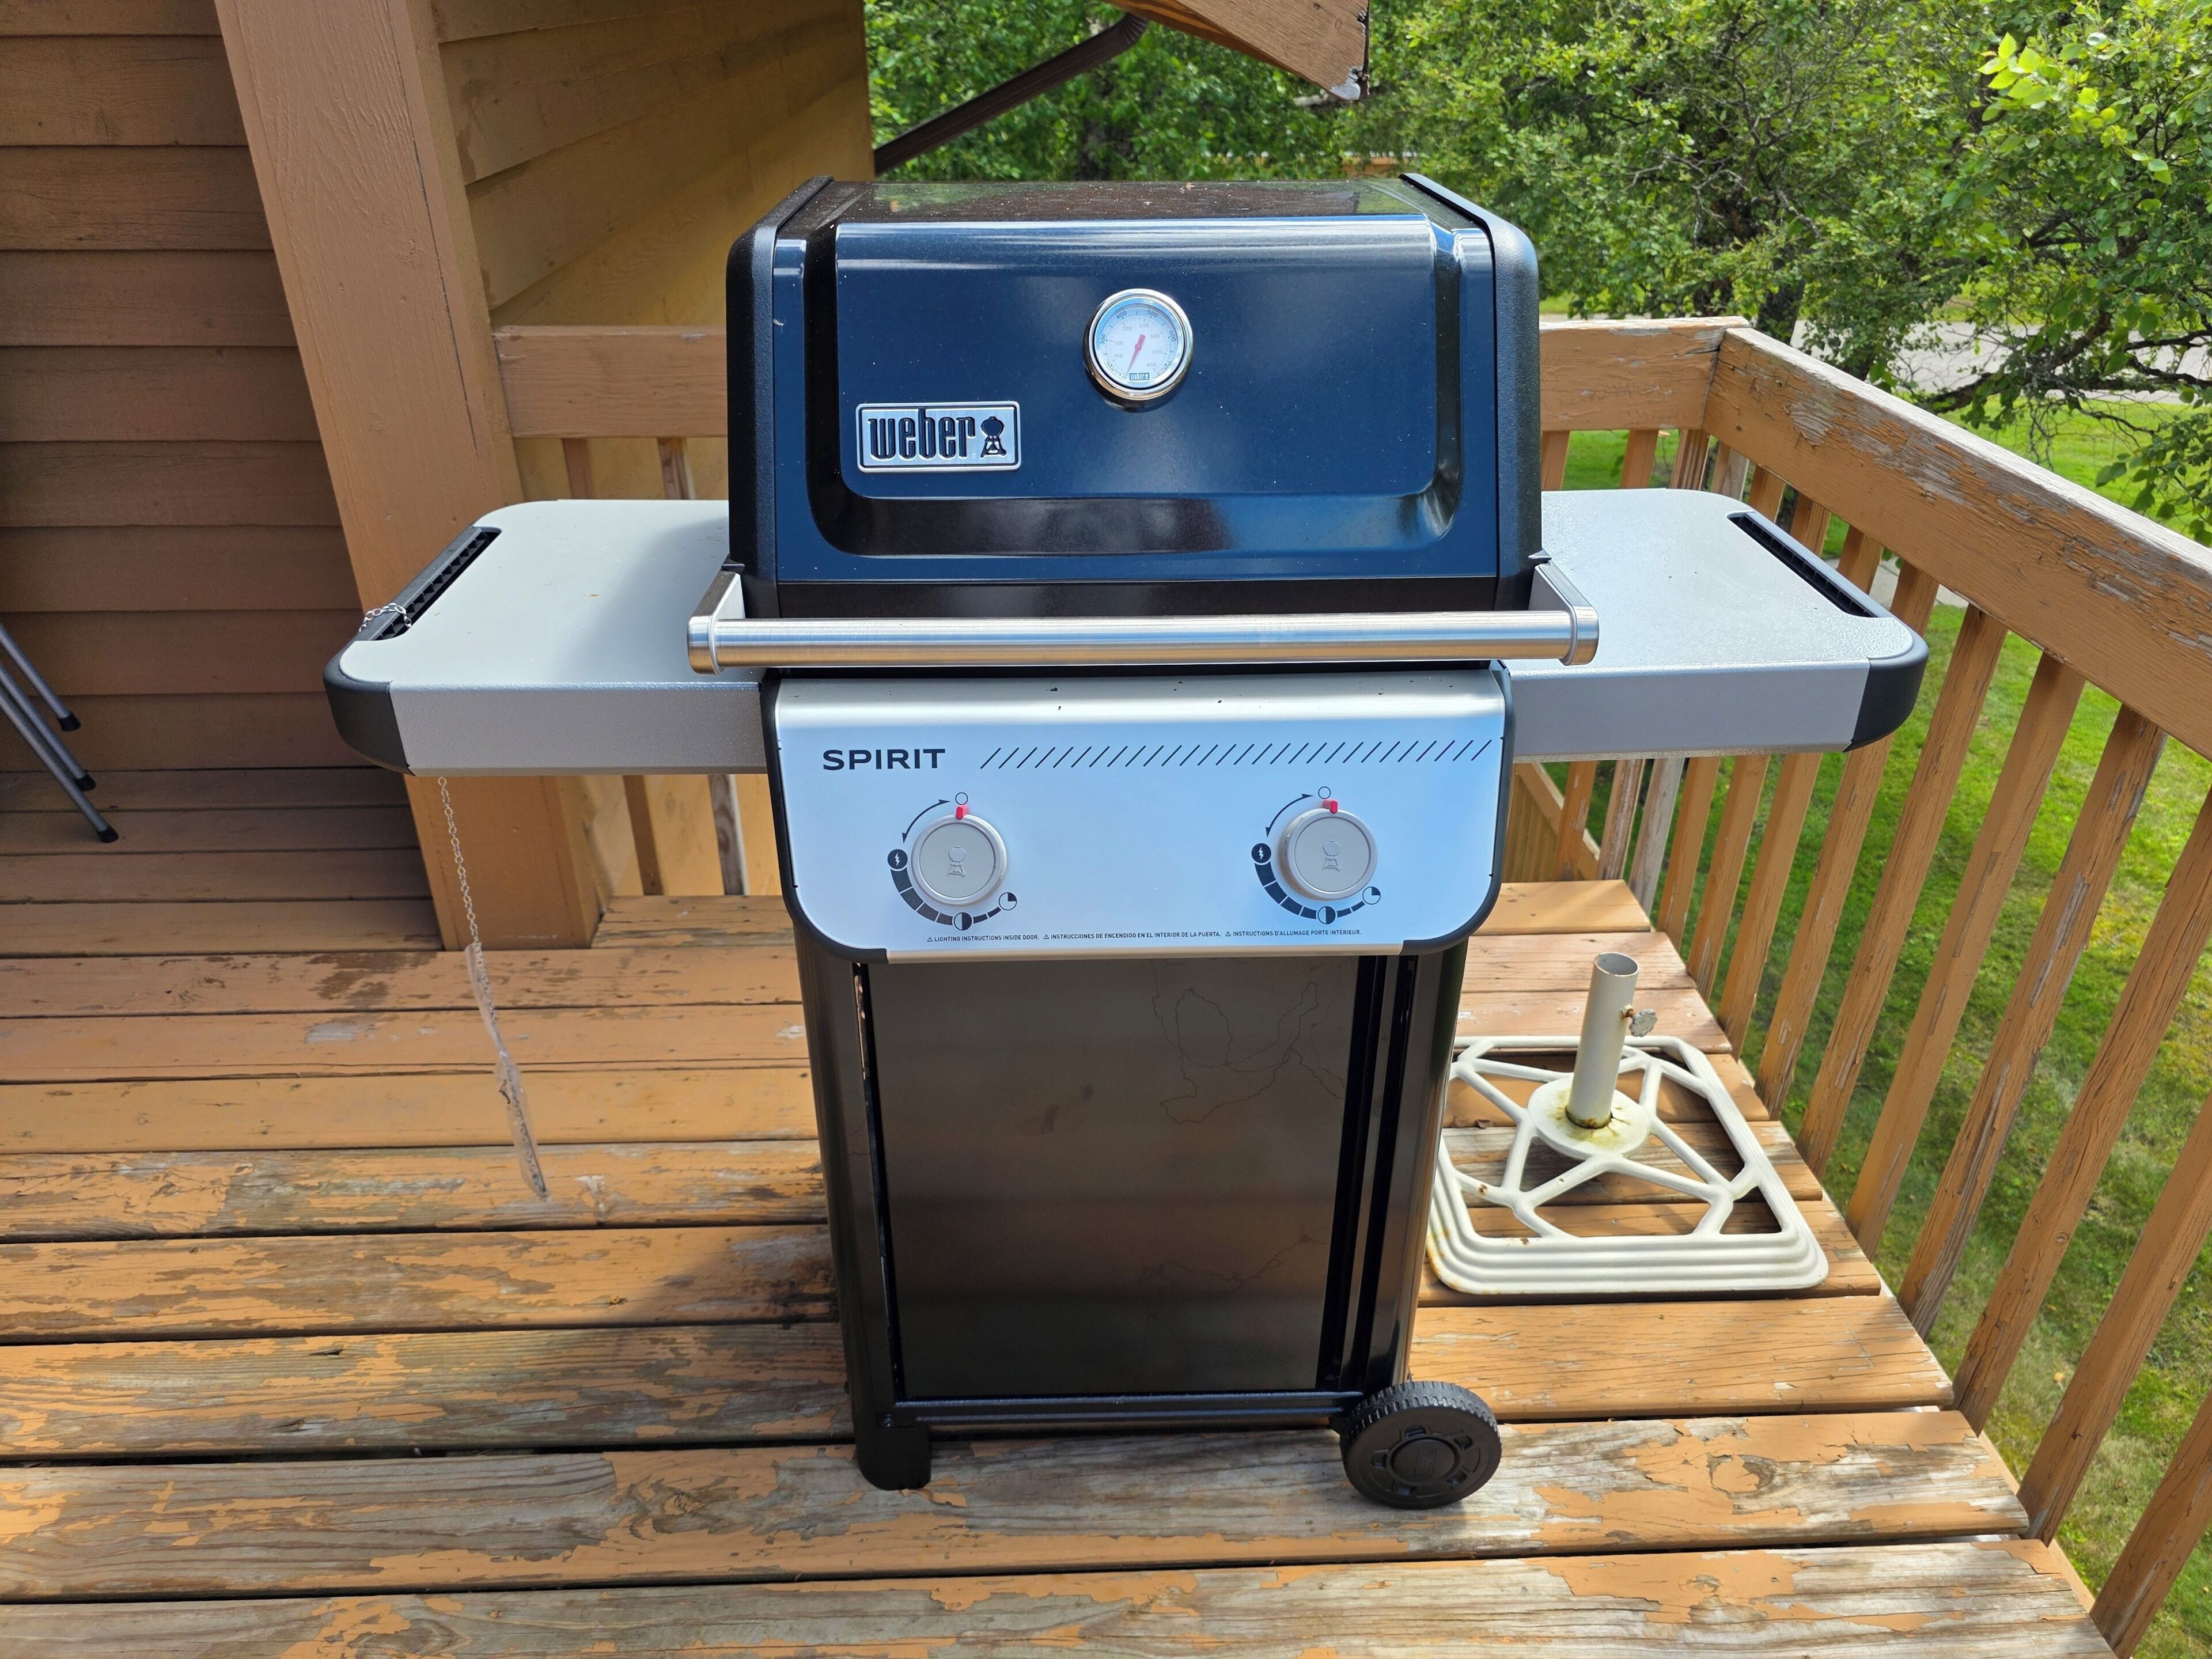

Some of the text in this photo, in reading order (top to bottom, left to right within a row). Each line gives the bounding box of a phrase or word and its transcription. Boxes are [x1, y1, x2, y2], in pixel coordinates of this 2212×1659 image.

[1116, 310, 1127, 319] 400
[1146, 310, 1158, 318] 500
[866, 407, 975, 460] weber
[823, 748, 946, 771] SPIRIT
